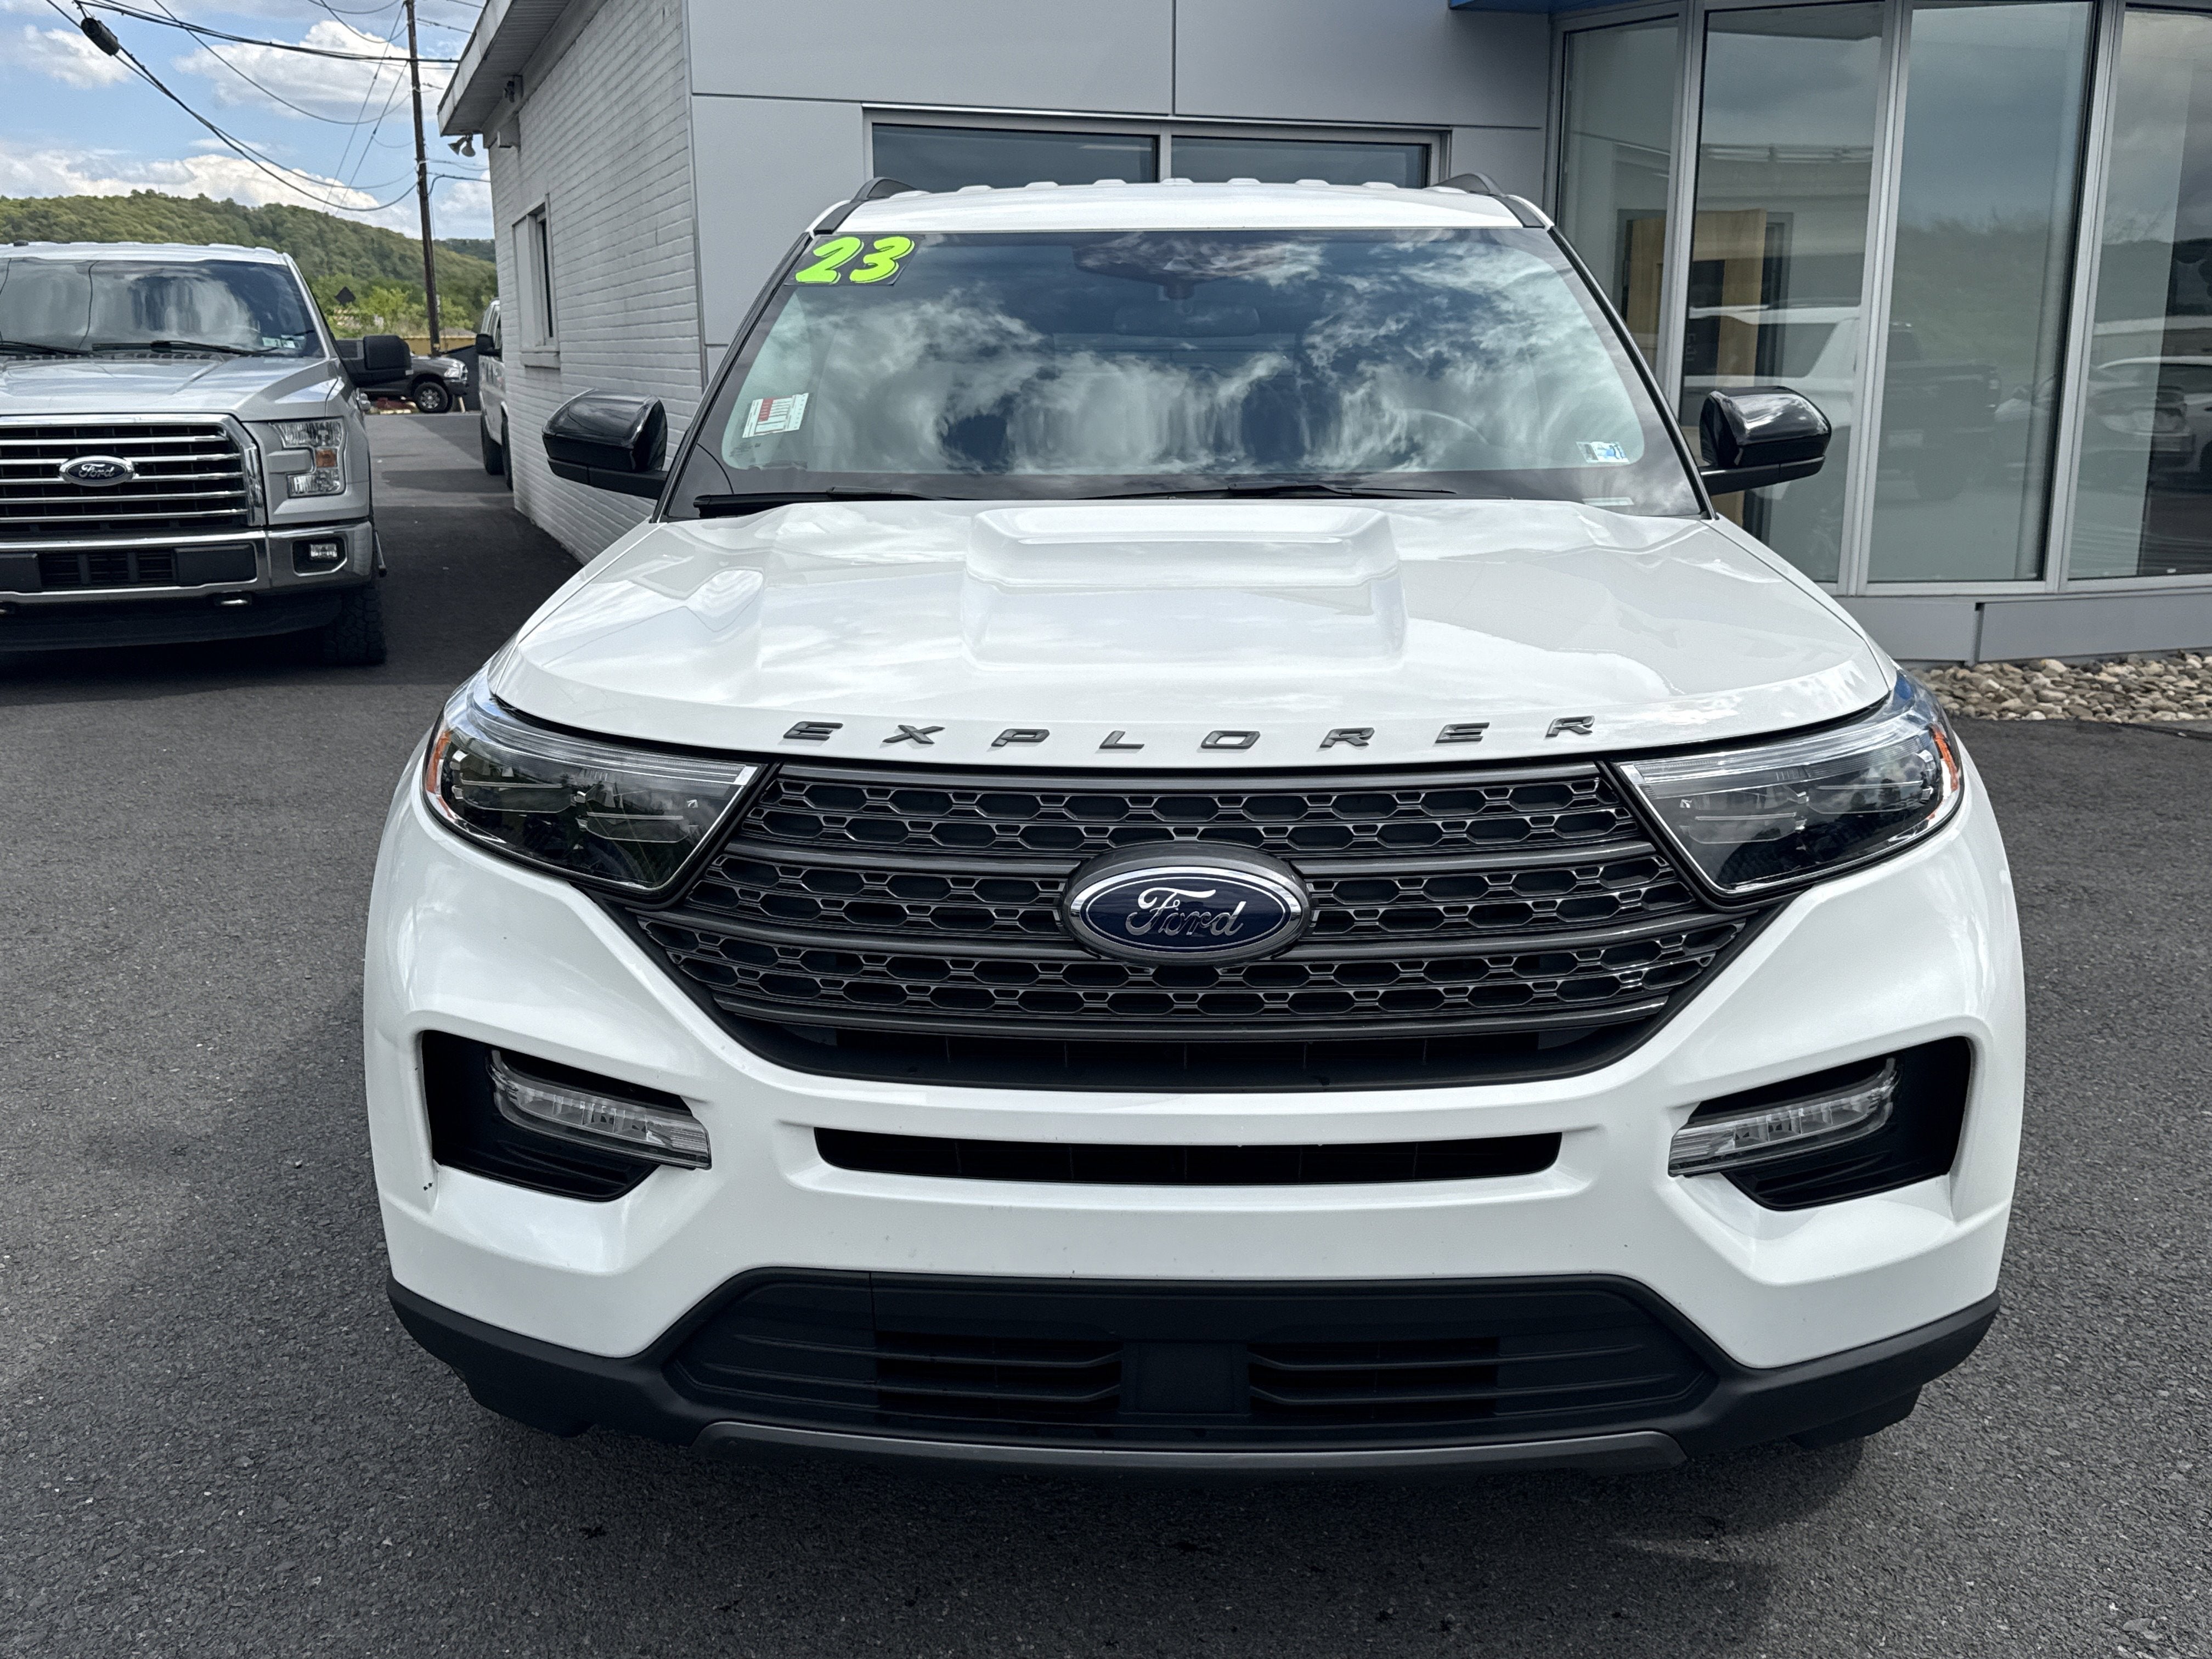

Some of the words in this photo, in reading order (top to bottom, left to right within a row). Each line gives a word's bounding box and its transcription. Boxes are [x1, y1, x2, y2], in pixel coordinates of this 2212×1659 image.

[795, 236, 915, 284] 23
[78, 463, 115, 478] Ford
[782, 715, 1595, 749] EXPLORER
[1125, 887, 1246, 936] Ford
